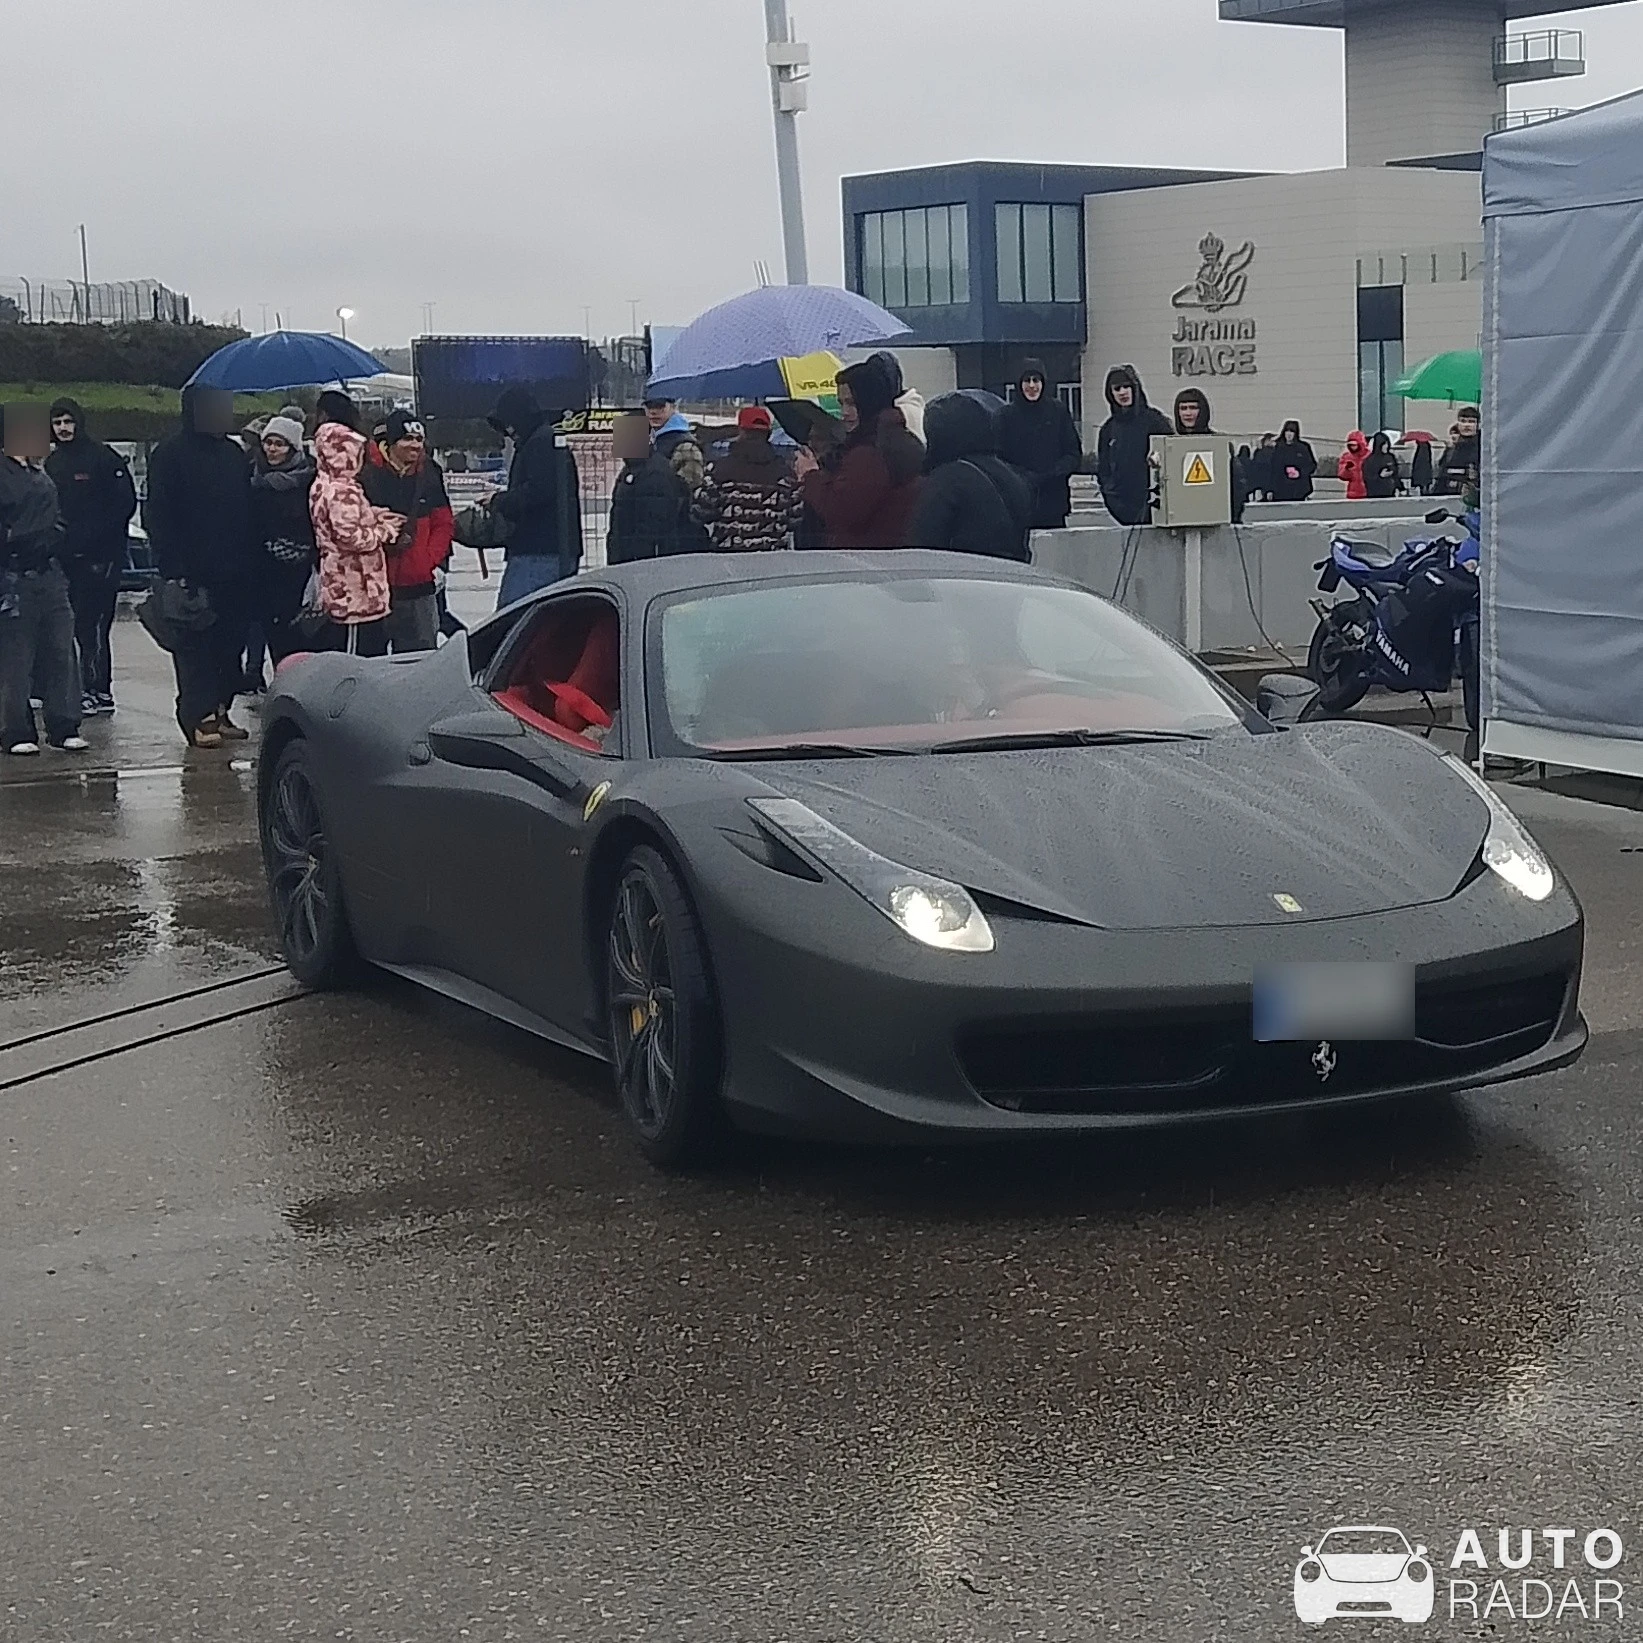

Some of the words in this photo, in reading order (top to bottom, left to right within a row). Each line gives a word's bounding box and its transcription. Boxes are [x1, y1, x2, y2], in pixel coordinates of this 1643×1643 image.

[1172, 316, 1255, 341] Jarama
[1172, 344, 1257, 376] RACE
[1376, 629, 1409, 676] YAMAHA
